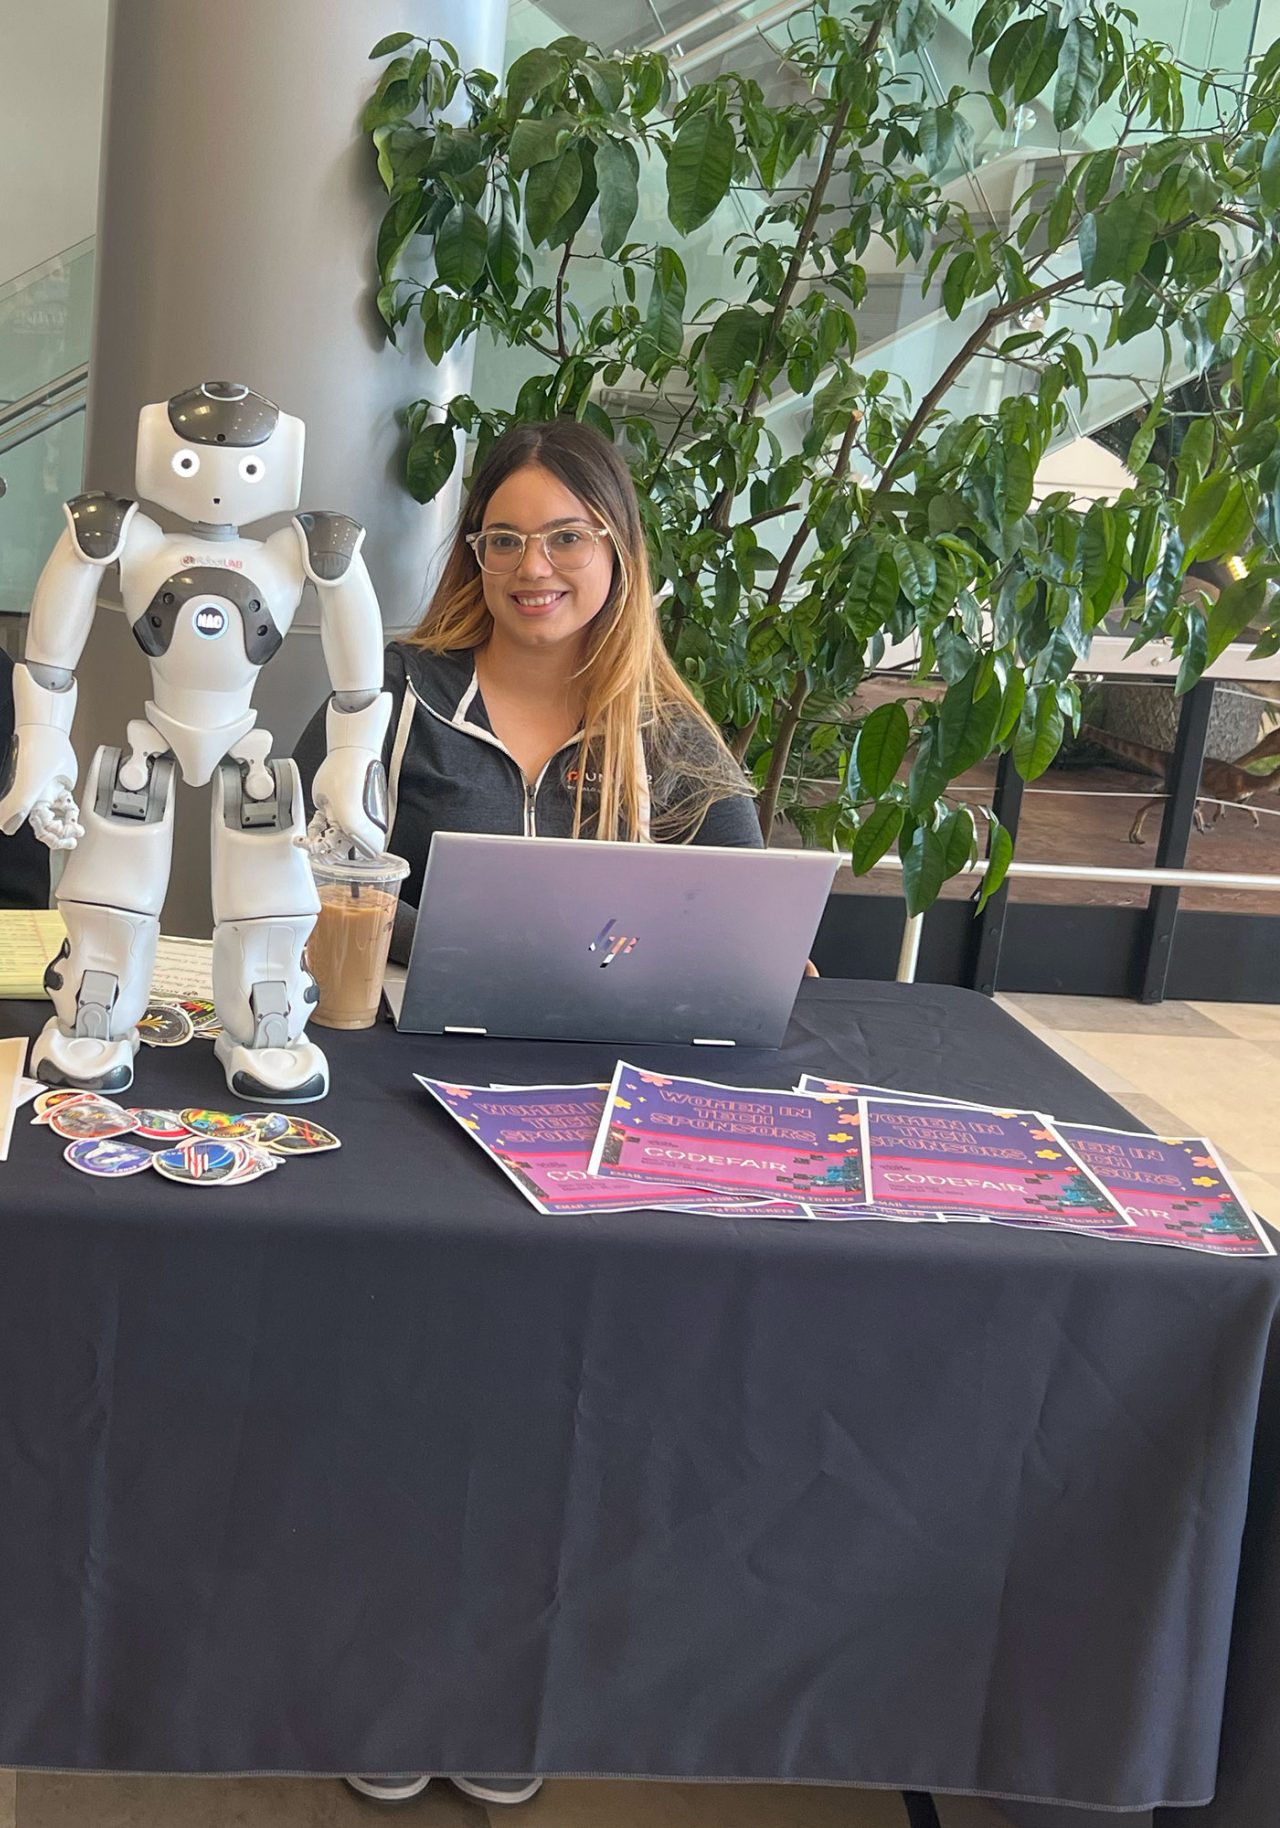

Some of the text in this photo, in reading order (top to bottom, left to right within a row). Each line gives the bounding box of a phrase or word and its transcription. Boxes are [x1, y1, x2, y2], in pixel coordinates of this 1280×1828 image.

[472, 1102, 586, 1115] WOMEN
[659, 1089, 812, 1119] WOMEN IN
[694, 1107, 774, 1126] TECH
[650, 1112, 817, 1142] SPONSORS
[892, 1125, 978, 1144] TECH
[969, 1122, 1005, 1136] IN
[644, 1147, 788, 1173] CODEFAIR
[1128, 1147, 1164, 1162] IN
[883, 1172, 1029, 1194] CODEFAIR
